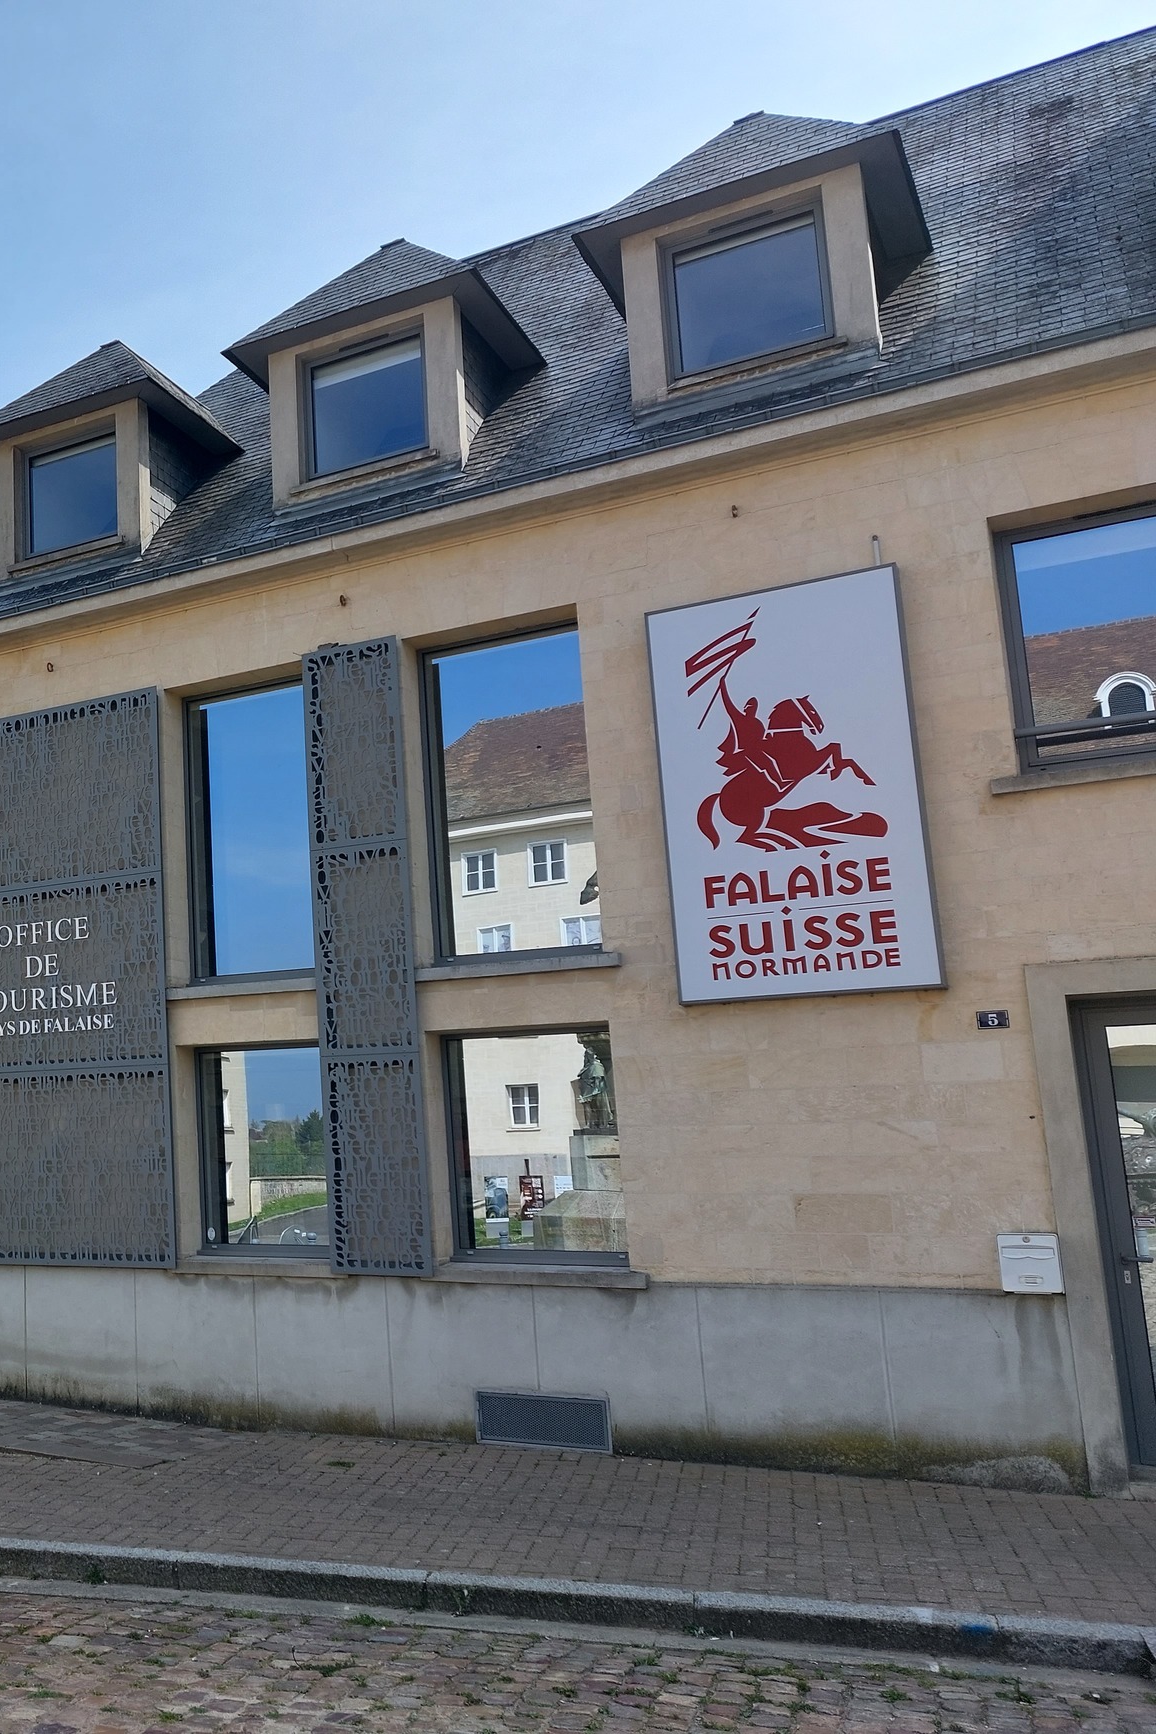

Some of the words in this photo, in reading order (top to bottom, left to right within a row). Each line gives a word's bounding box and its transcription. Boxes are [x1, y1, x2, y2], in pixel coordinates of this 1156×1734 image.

[25, 953, 60, 978] DE
[19, 1018, 41, 1035] DE
[44, 1013, 116, 1034] FALAISE
[988, 1013, 999, 1026] 5
